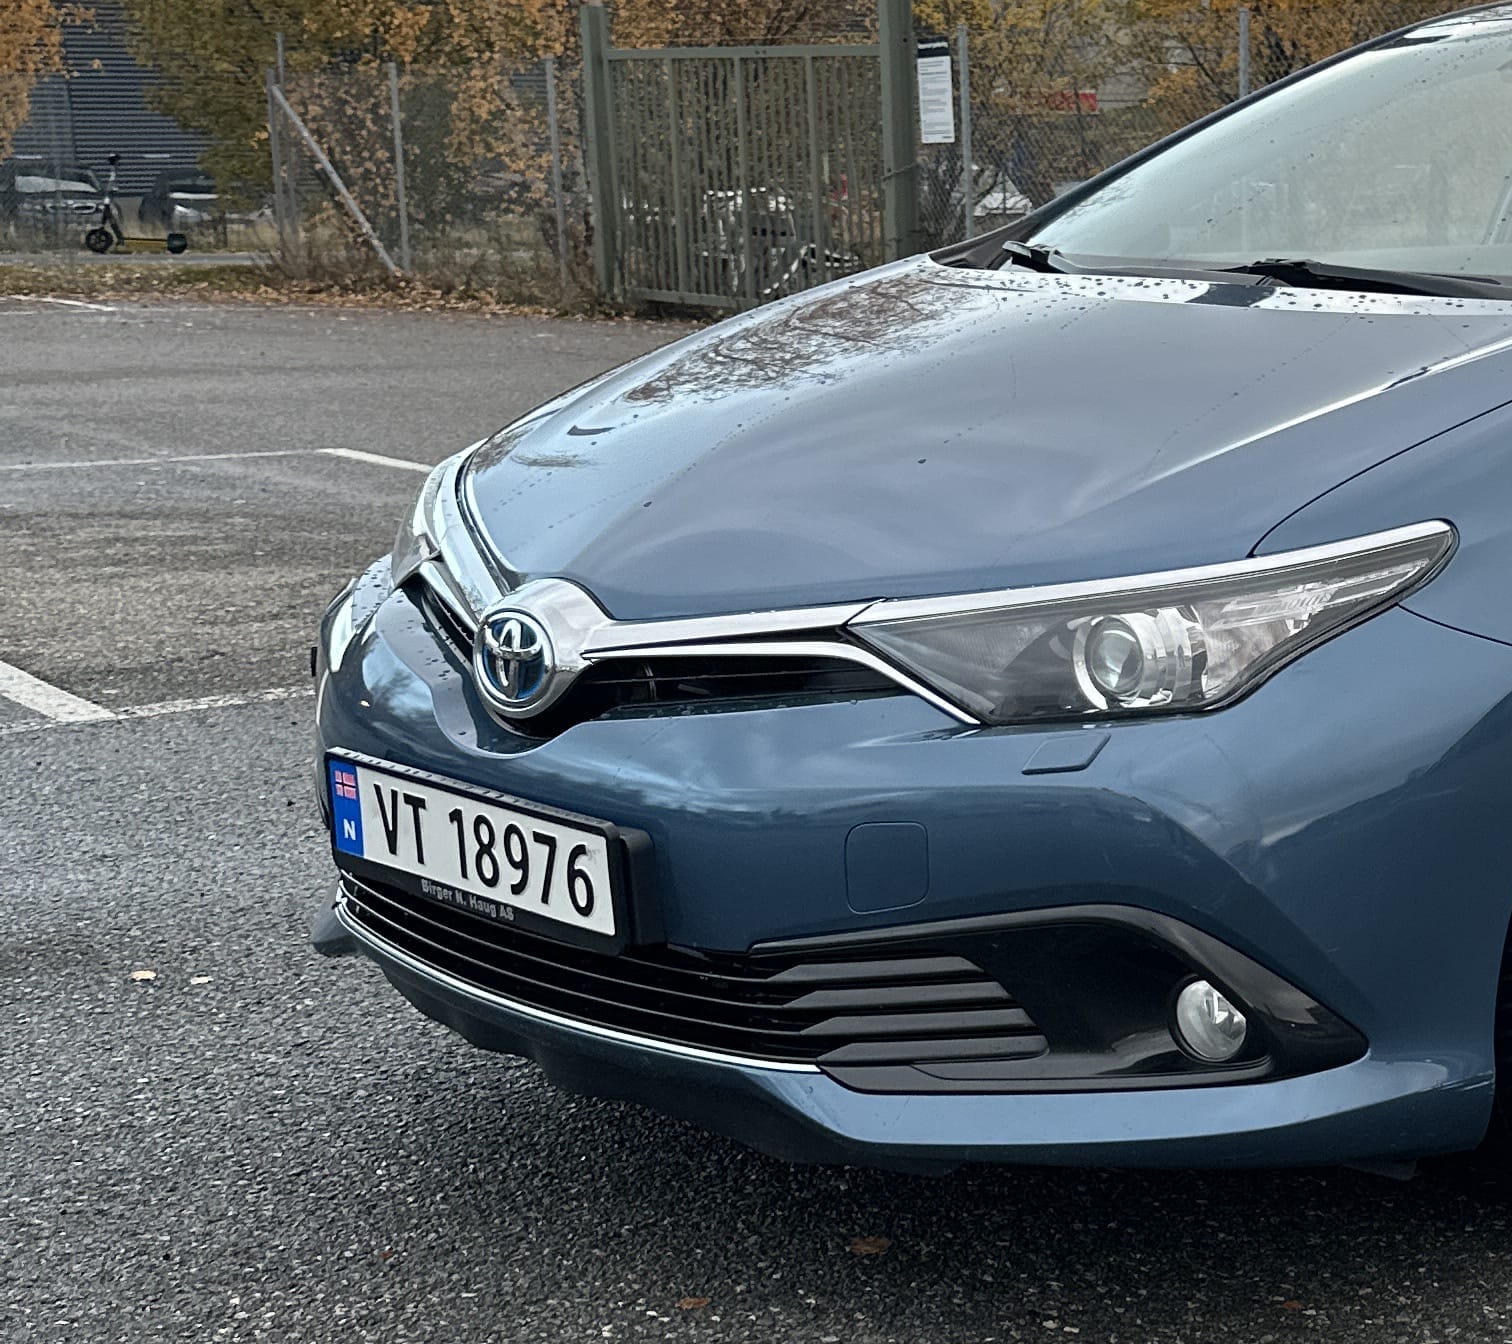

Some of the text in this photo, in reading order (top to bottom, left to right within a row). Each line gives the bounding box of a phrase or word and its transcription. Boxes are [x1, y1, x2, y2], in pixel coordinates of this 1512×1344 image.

[343, 818, 356, 841] N
[373, 783, 595, 917] VT 18976
[421, 878, 453, 901] Birger
[469, 894, 497, 918] Haug
[499, 903, 515, 922] AS
